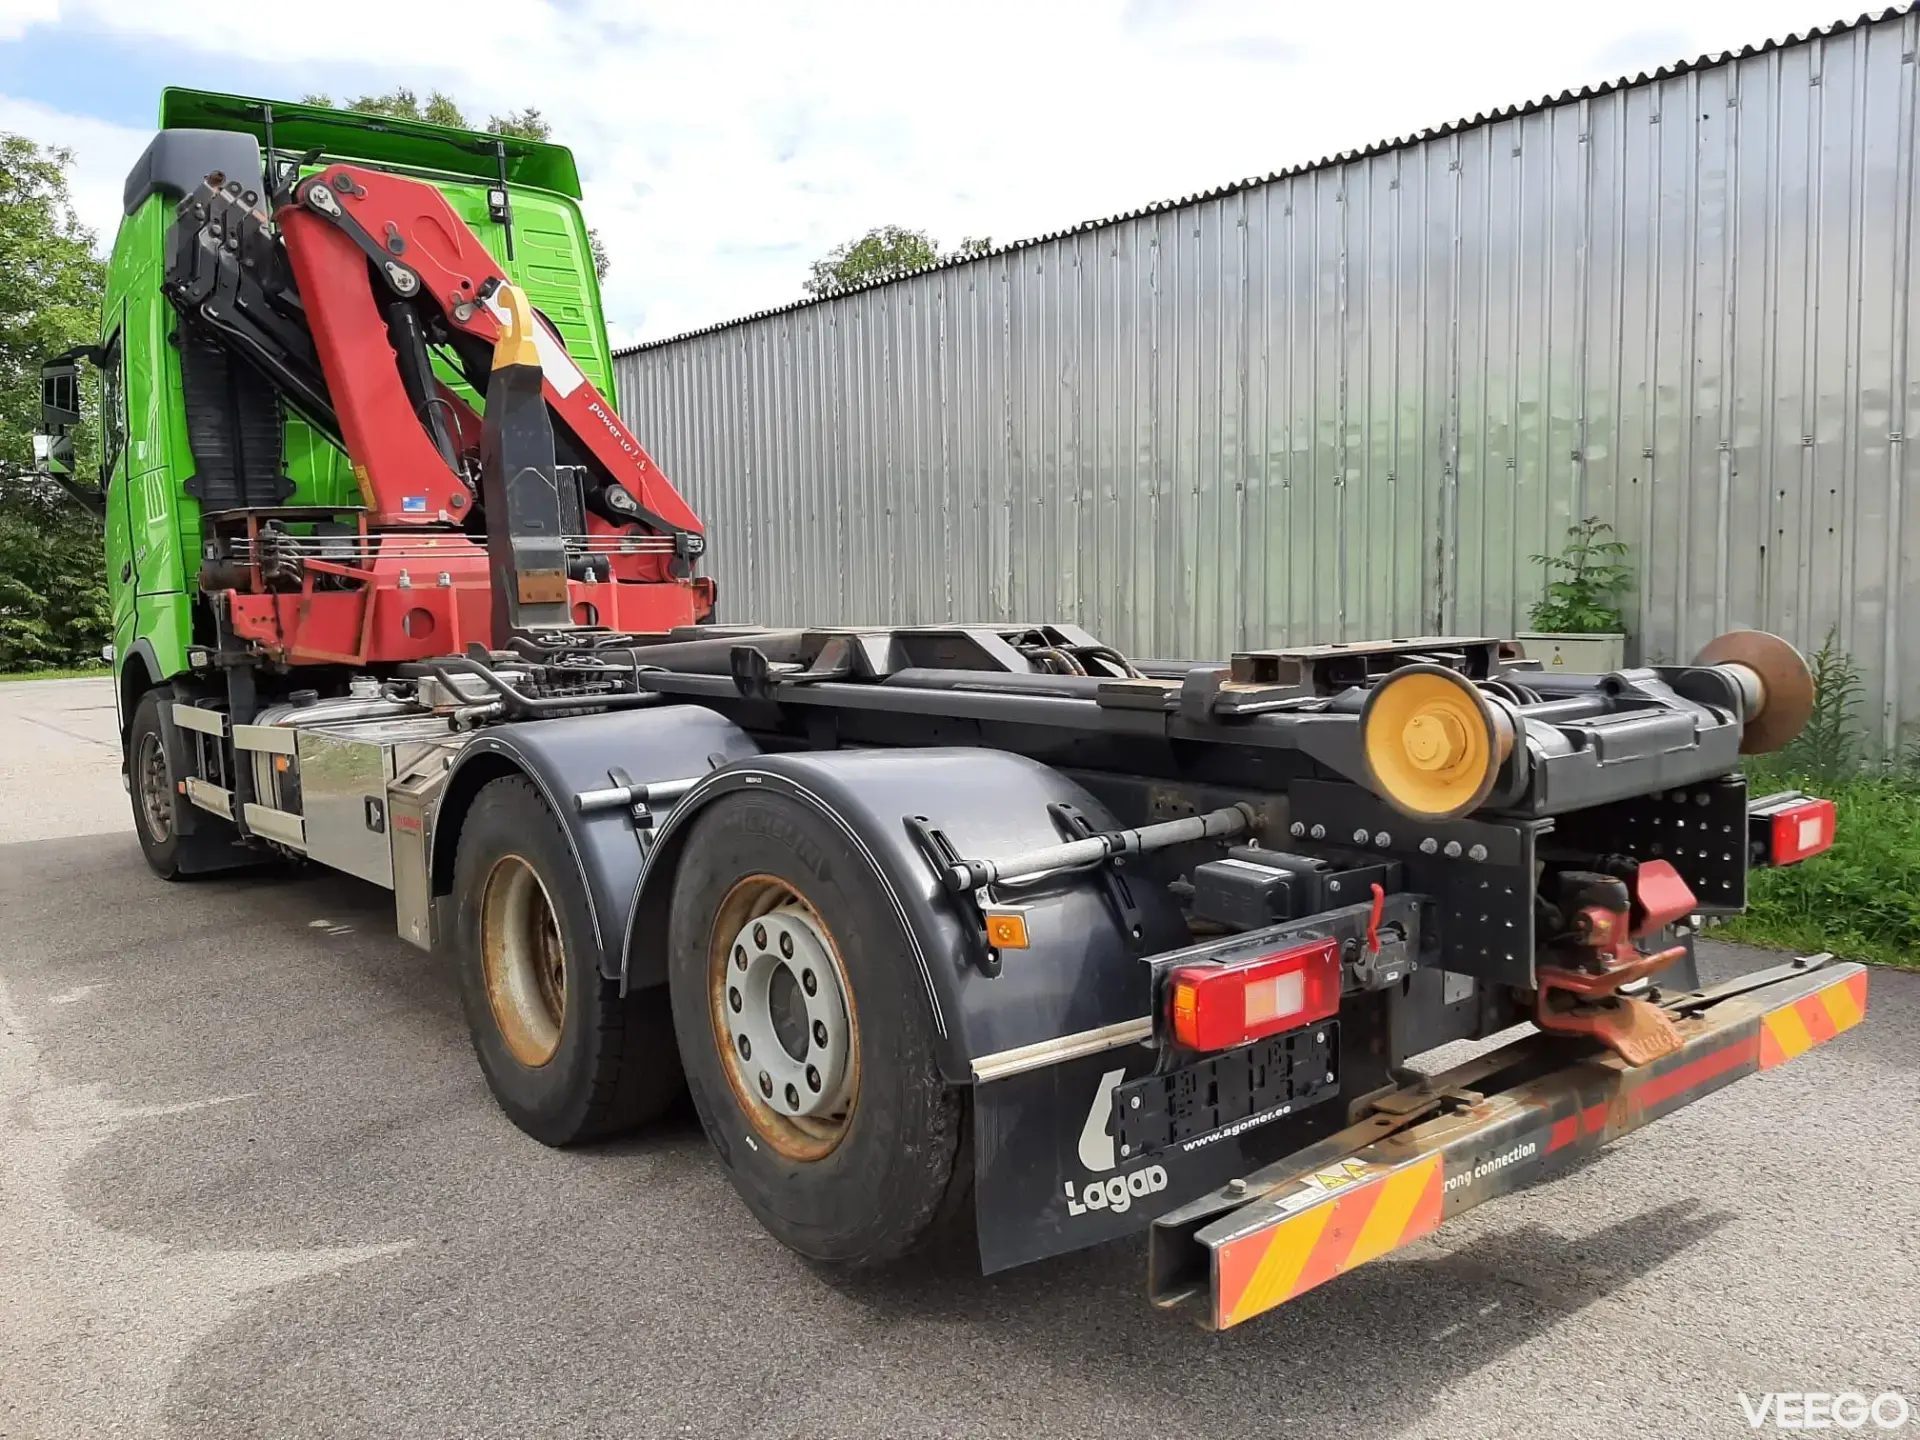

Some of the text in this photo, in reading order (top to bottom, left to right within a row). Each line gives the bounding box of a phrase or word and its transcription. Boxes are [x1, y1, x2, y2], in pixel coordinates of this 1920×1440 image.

[588, 402, 621, 439] power
[1182, 1105, 1291, 1152] www.agomer.ee
[1442, 1142, 1536, 1193] rong connection
